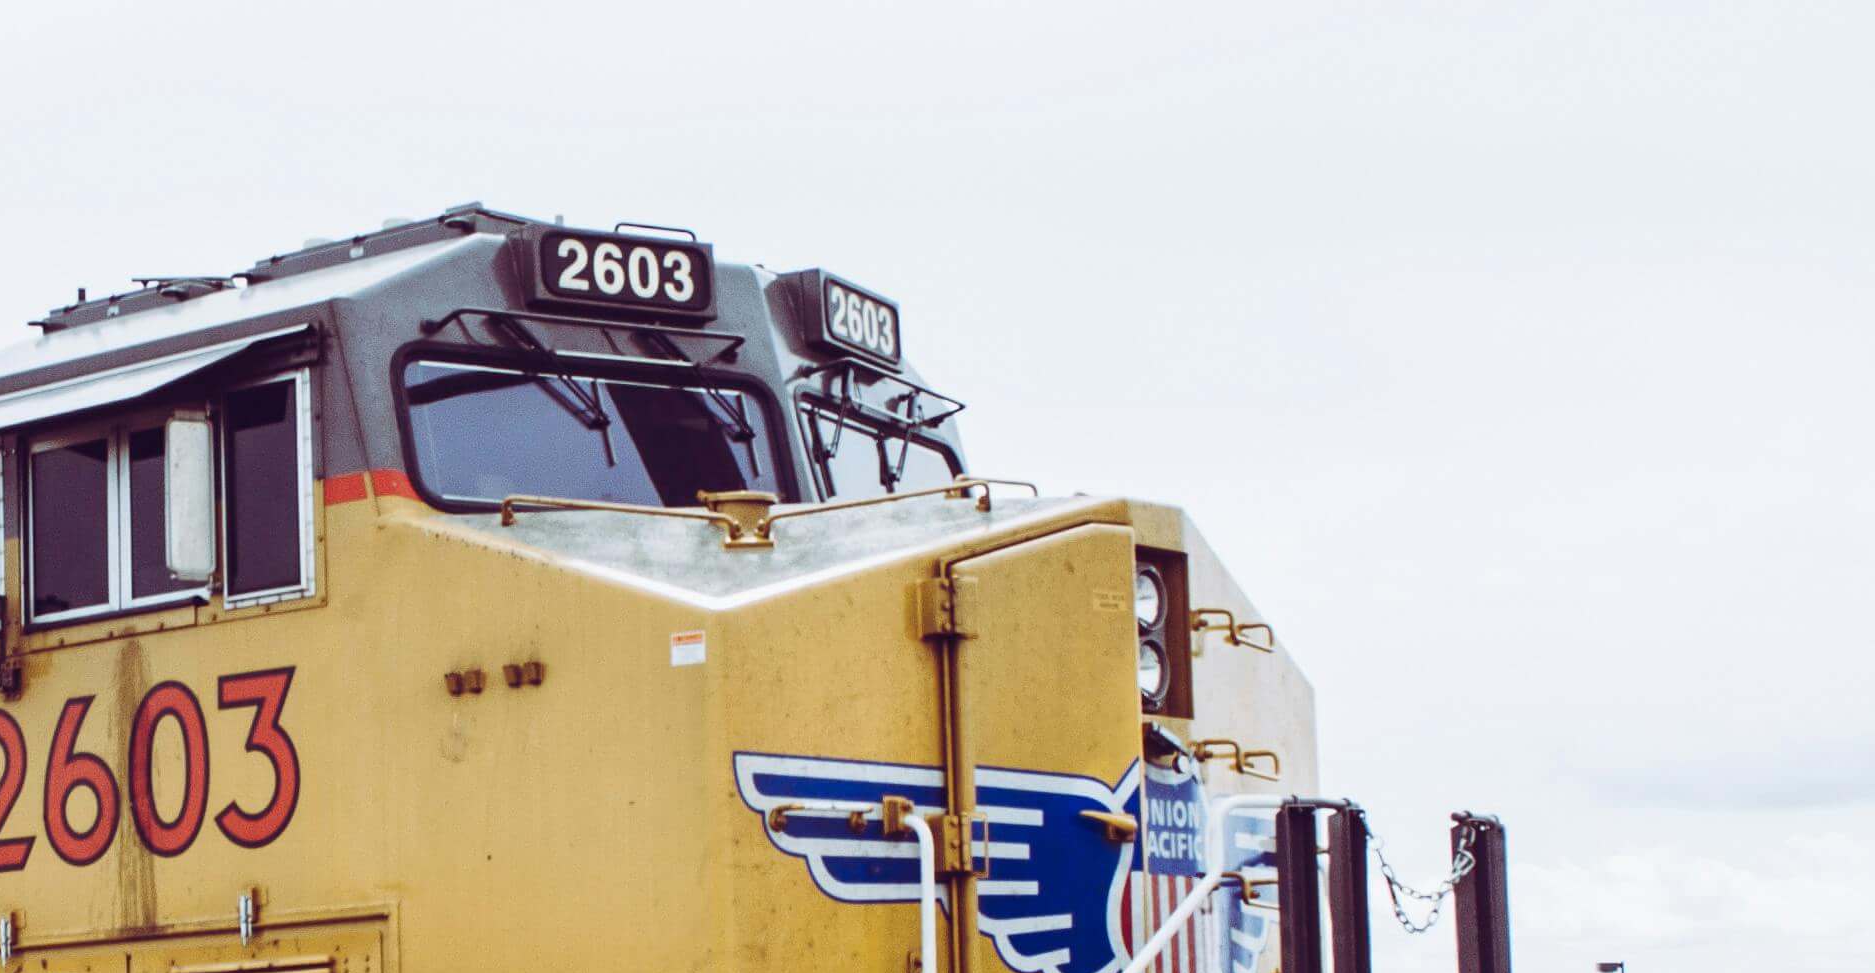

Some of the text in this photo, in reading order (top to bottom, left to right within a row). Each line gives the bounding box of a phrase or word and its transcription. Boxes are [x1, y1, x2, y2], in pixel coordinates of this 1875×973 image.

[556, 237, 696, 303] 2603
[828, 285, 896, 357] 2603
[1145, 797, 1202, 830] NION
[1147, 829, 1204, 862] ACIFIC
